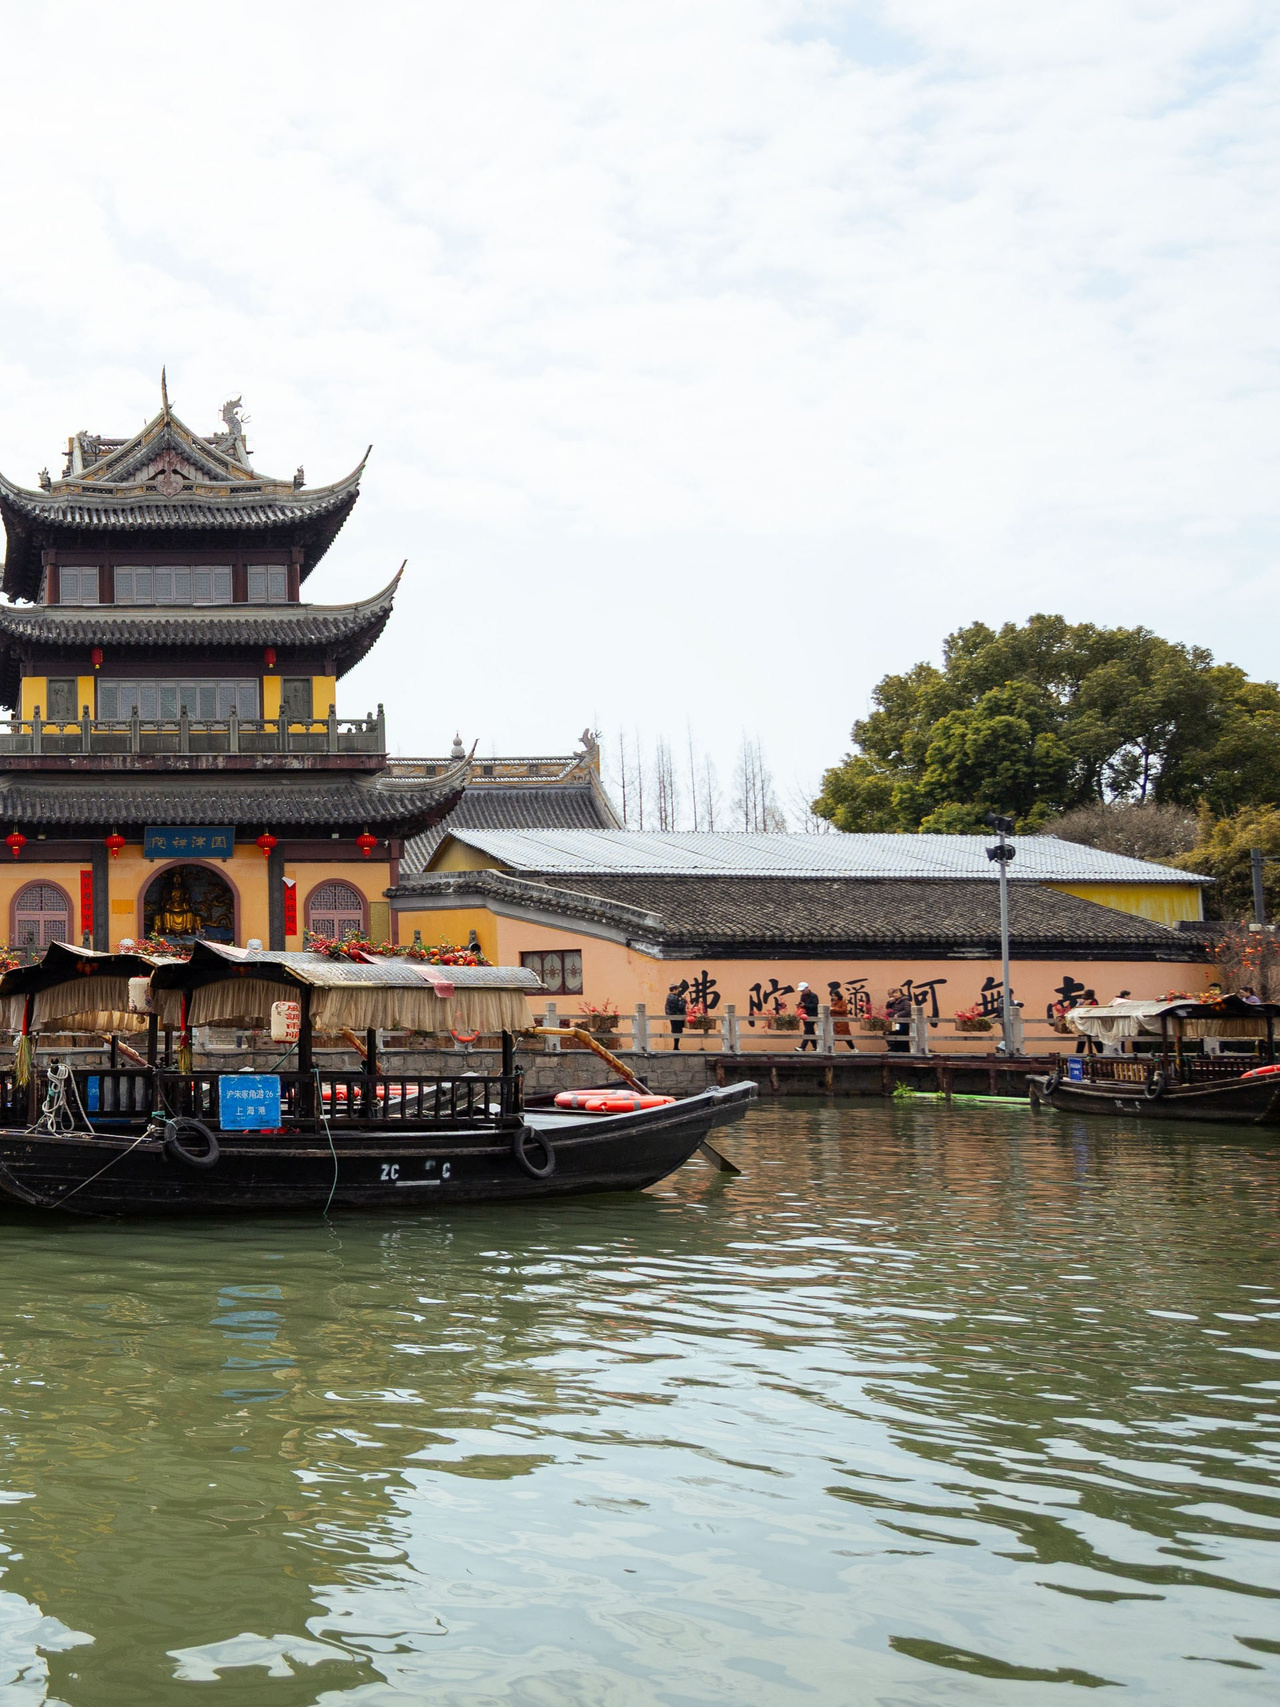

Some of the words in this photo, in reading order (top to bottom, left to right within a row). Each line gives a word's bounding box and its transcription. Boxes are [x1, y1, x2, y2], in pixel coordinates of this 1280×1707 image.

[235, 1106, 266, 1116] 上海港
[380, 1163, 400, 1180] ZC
